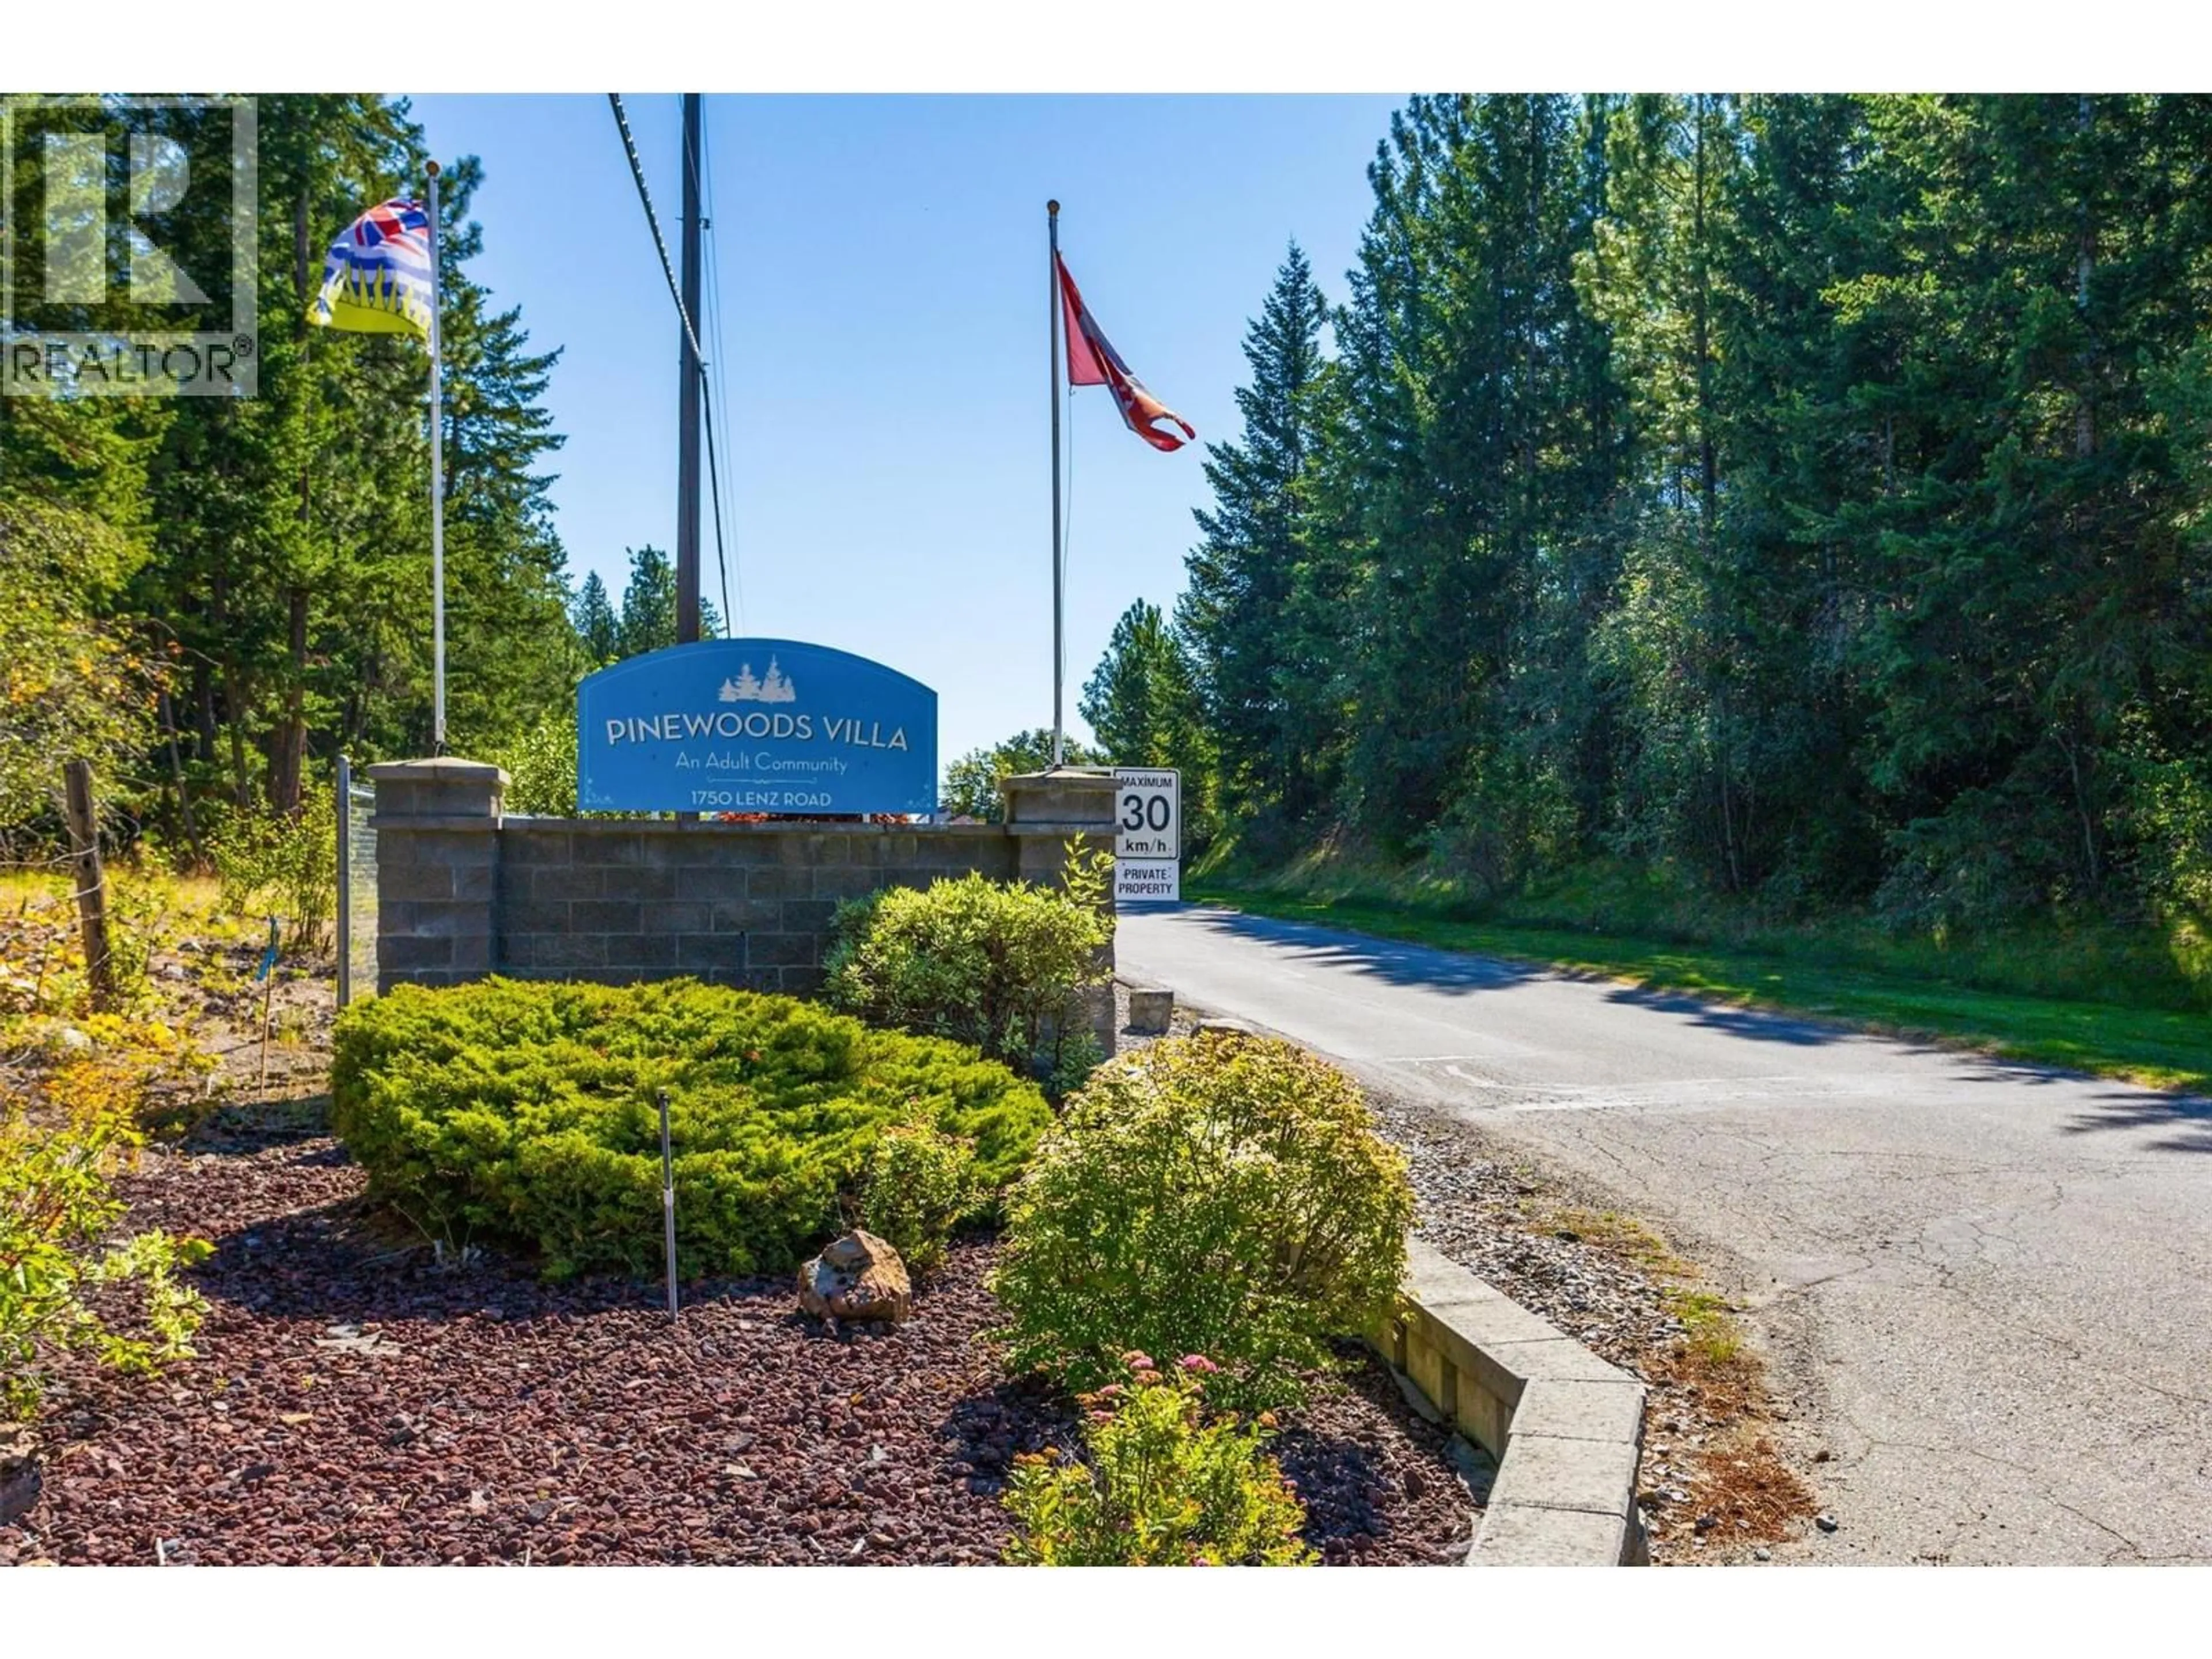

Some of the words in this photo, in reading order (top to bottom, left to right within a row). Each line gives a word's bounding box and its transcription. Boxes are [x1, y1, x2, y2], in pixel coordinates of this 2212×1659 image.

[606, 712, 812, 745] PINEWOODS
[823, 716, 908, 751] VILLA
[675, 752, 699, 768] An
[706, 751, 749, 770] Adult
[755, 751, 848, 775] Community
[1122, 777, 1172, 787] MAXIMUM
[691, 791, 732, 806] 1750
[736, 791, 778, 806] LENZ
[784, 791, 832, 806] ROAD
[1122, 794, 1170, 831] 30
[1126, 837, 1166, 854] km/h
[1124, 869, 1166, 880] PRIVATE
[1118, 882, 1173, 894] PROPERTY
